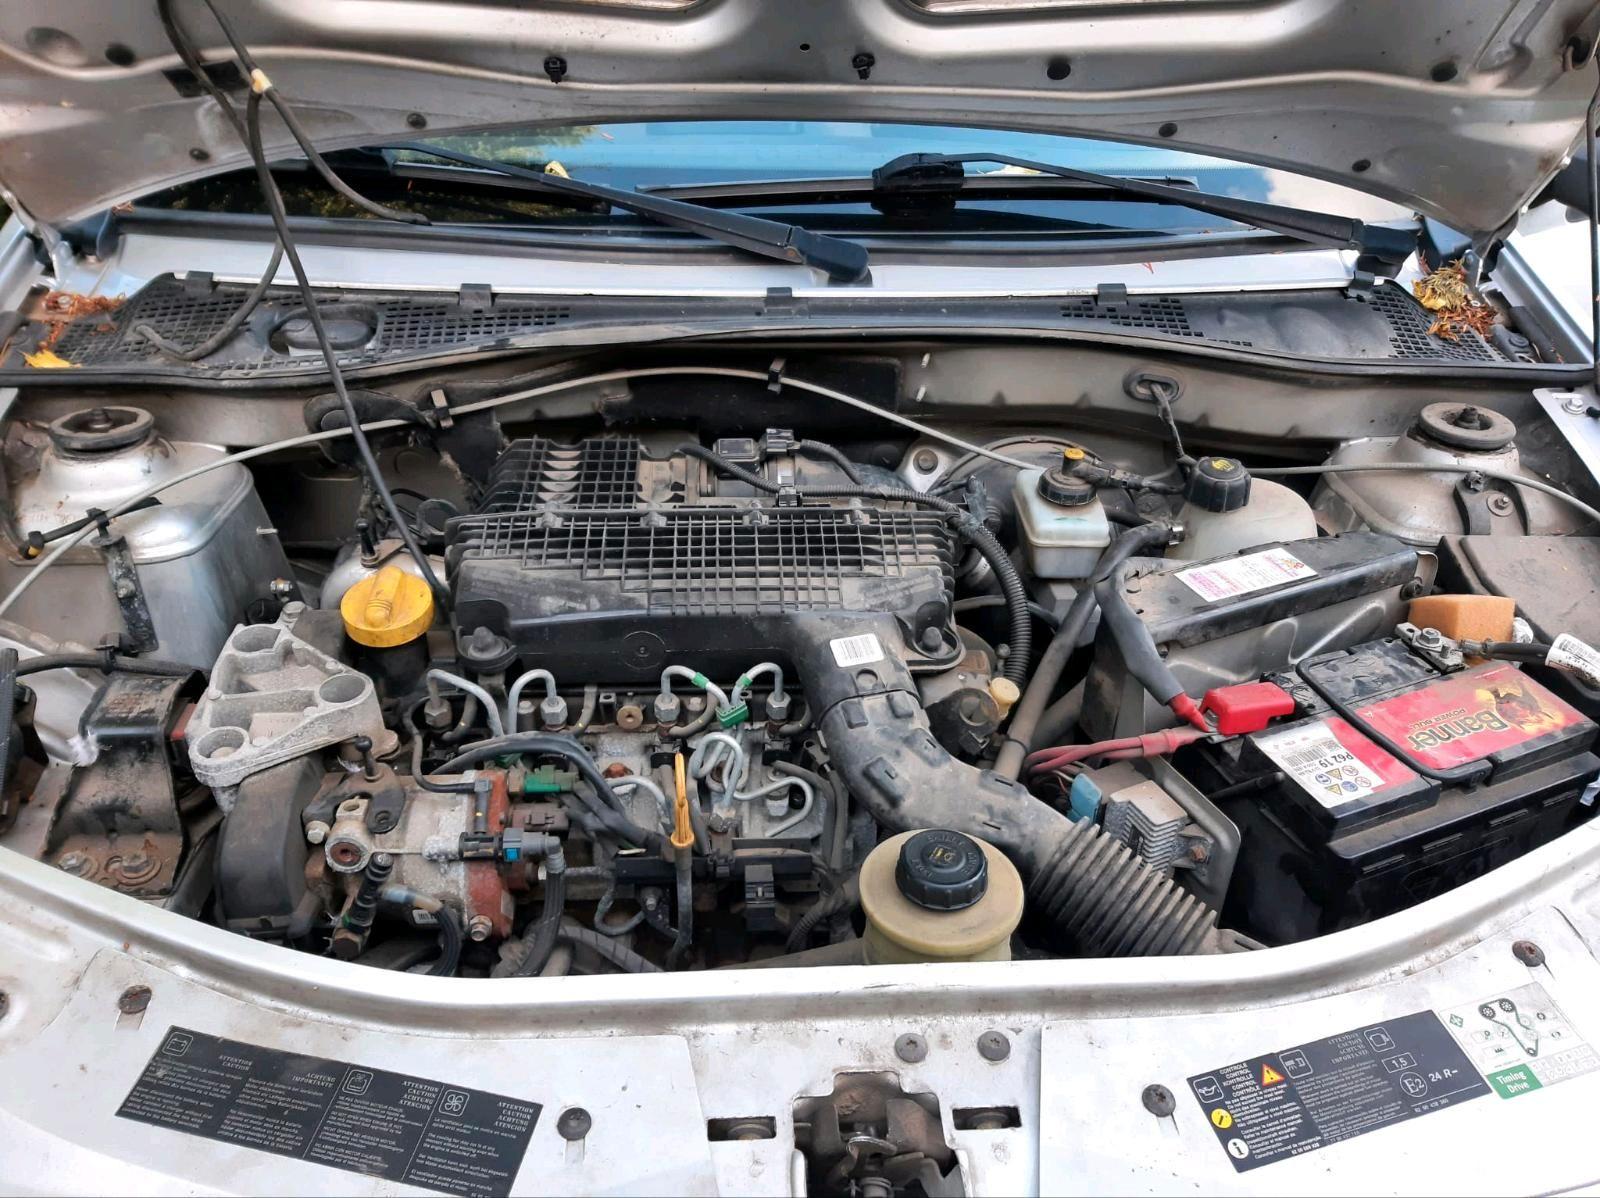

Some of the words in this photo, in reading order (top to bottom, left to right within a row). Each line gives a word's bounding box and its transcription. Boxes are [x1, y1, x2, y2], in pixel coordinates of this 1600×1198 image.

[1436, 708, 1466, 723] POWER
[1412, 716, 1434, 729] BULL
[1408, 708, 1508, 751] Banner
[1319, 757, 1334, 768] 19
[1331, 751, 1354, 763] P62
[218, 1055, 253, 1066] ATTENTION
[1391, 1057, 1410, 1070] 1,5
[222, 1062, 250, 1071] CAUTION
[306, 1073, 337, 1083] ACHTUNG
[1226, 1069, 1252, 1079] CONTROL
[1428, 1072, 1444, 1082] 24
[1496, 1070, 1527, 1085] Timing
[402, 1081, 440, 1093] ATTENTION
[1232, 1080, 1257, 1091] CONTROL
[1403, 1076, 1427, 1094] E2
[1507, 1080, 1530, 1094] Drive
[403, 1094, 434, 1104] ACHTUNG
[407, 1089, 437, 1099] CAUTION
[497, 1102, 534, 1114] ATTENTION
[502, 1109, 532, 1119] CAUTION
[498, 1115, 529, 1126] ACHTUNG
